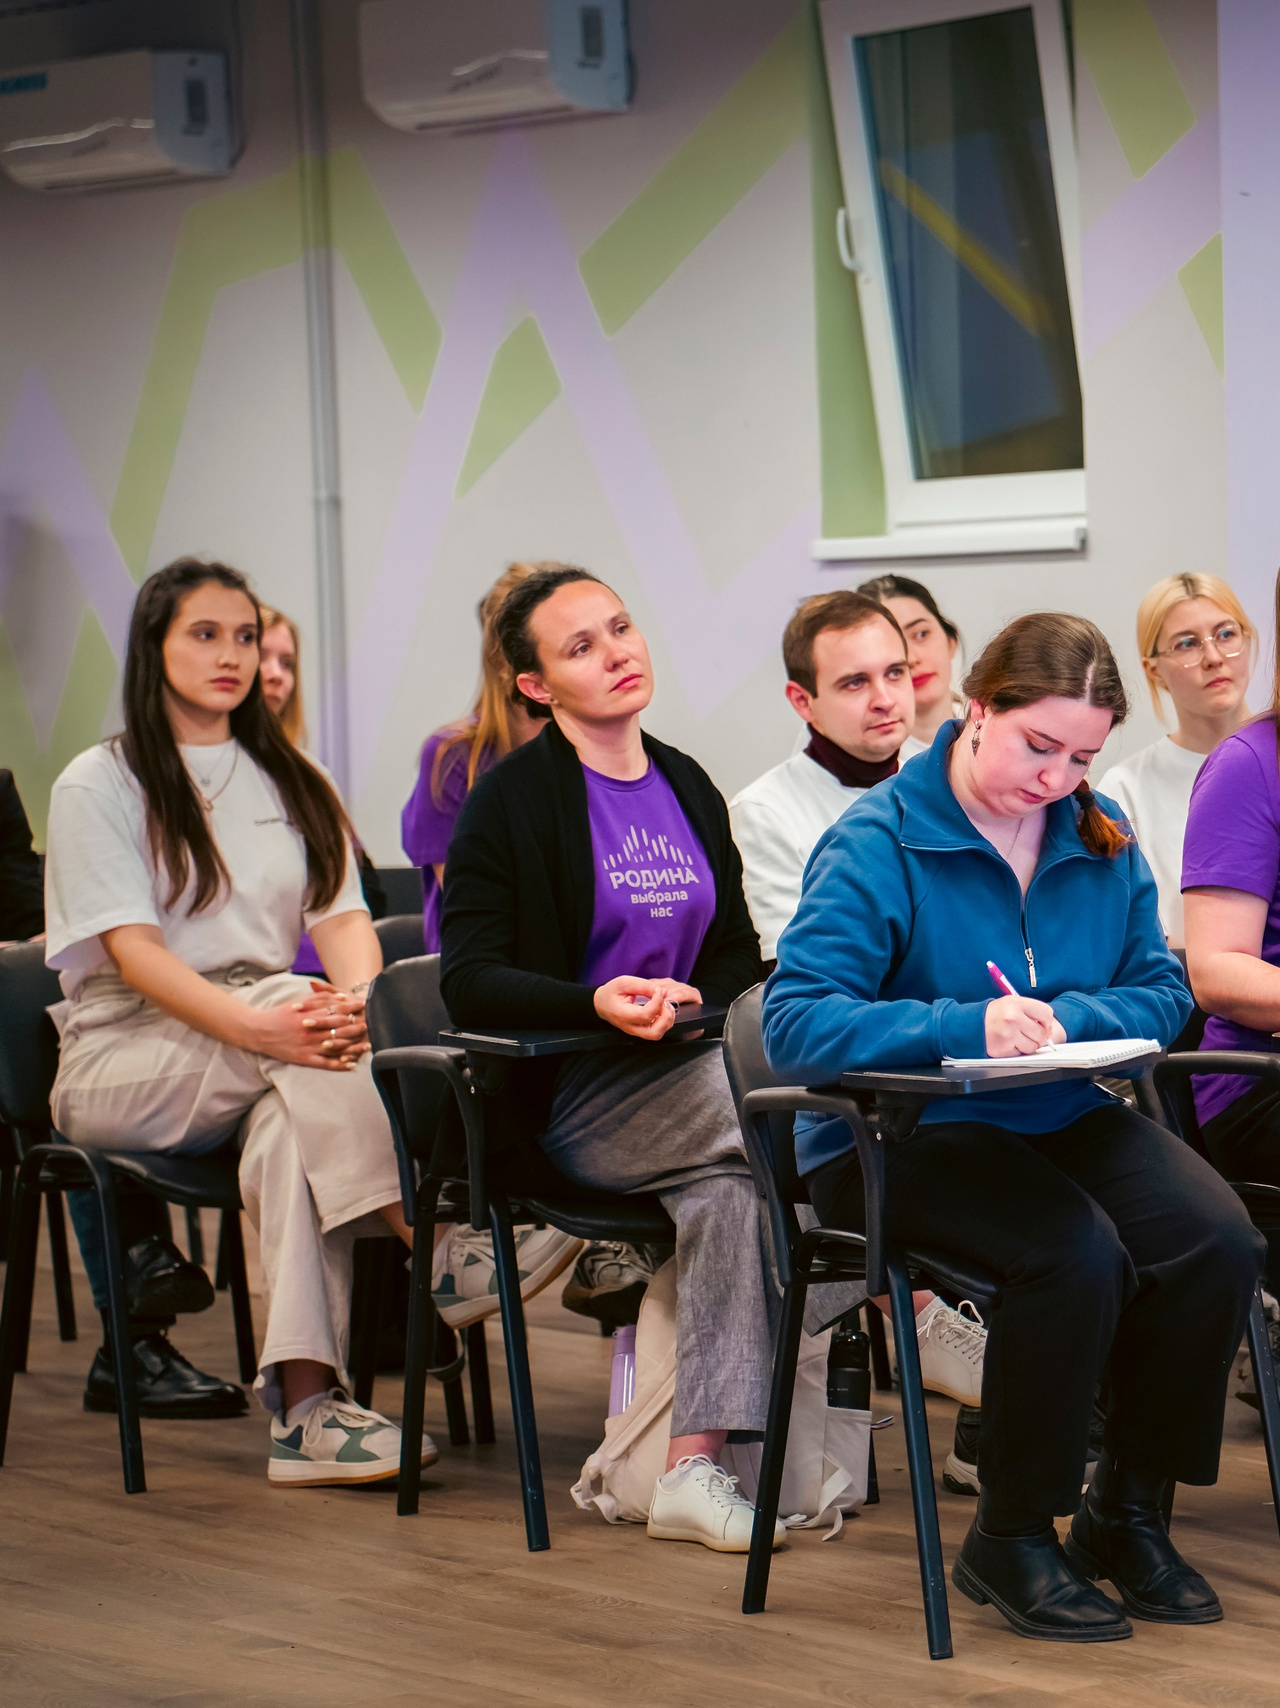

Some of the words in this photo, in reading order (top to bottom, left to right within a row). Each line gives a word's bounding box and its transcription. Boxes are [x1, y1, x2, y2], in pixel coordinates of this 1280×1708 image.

[609, 866, 700, 890] РОДИНА
[630, 890, 689, 905] выбрала
[650, 906, 673, 918] нас
